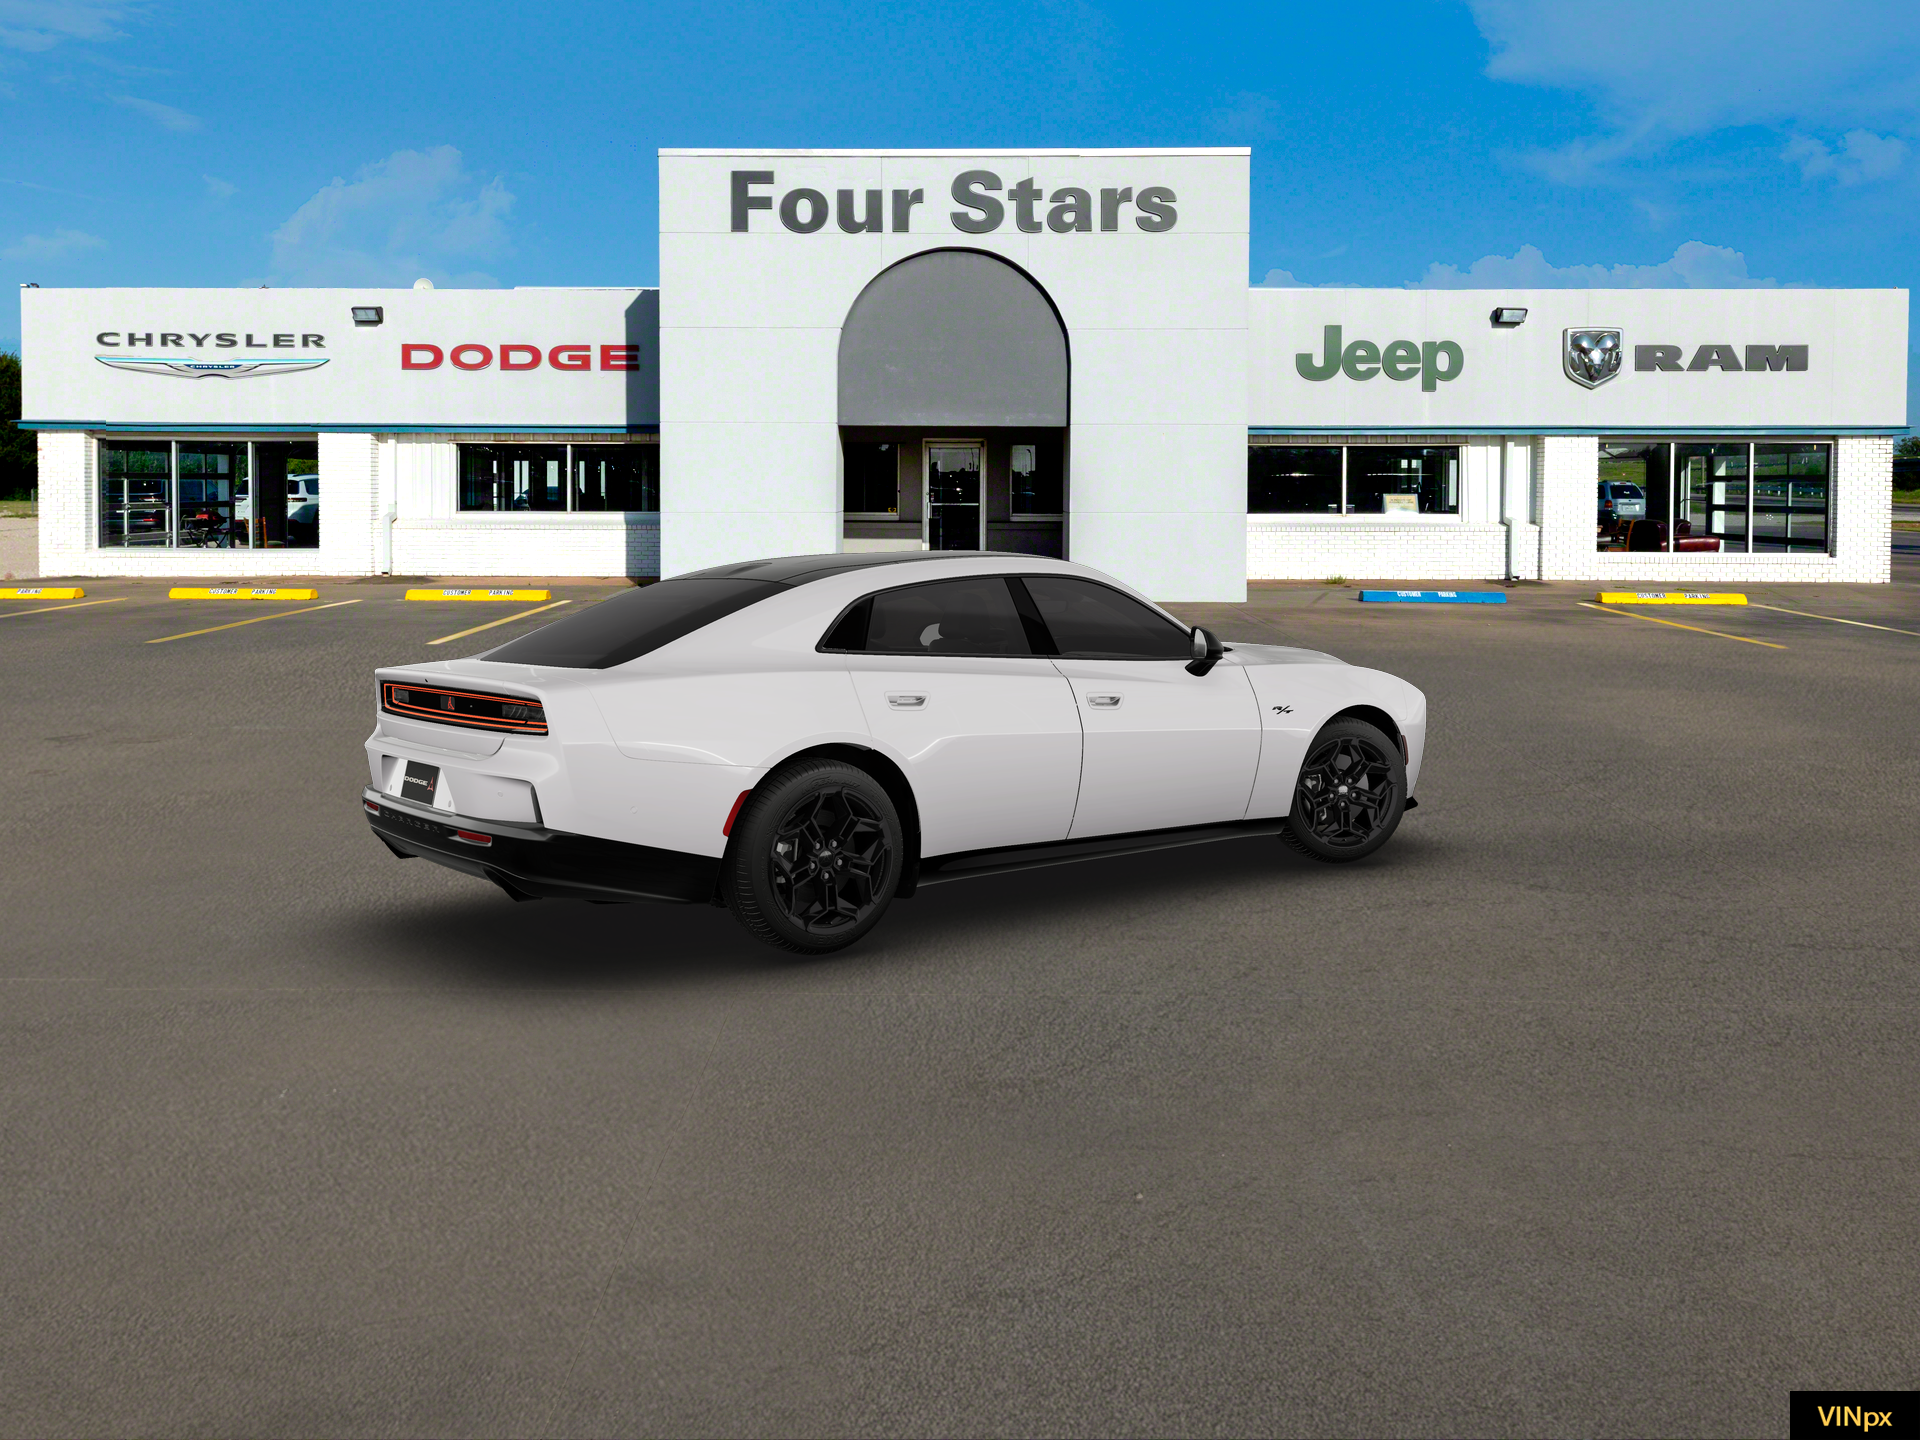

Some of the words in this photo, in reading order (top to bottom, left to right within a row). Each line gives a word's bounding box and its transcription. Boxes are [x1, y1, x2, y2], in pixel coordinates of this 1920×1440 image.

[731, 170, 924, 234] Four
[950, 169, 1178, 234] Stars
[96, 332, 326, 348] CHRYSLER
[401, 344, 640, 371] DODGE
[1296, 325, 1464, 392] Jeep
[1635, 345, 1809, 371] RAM
[404, 775, 428, 787] DODGE
